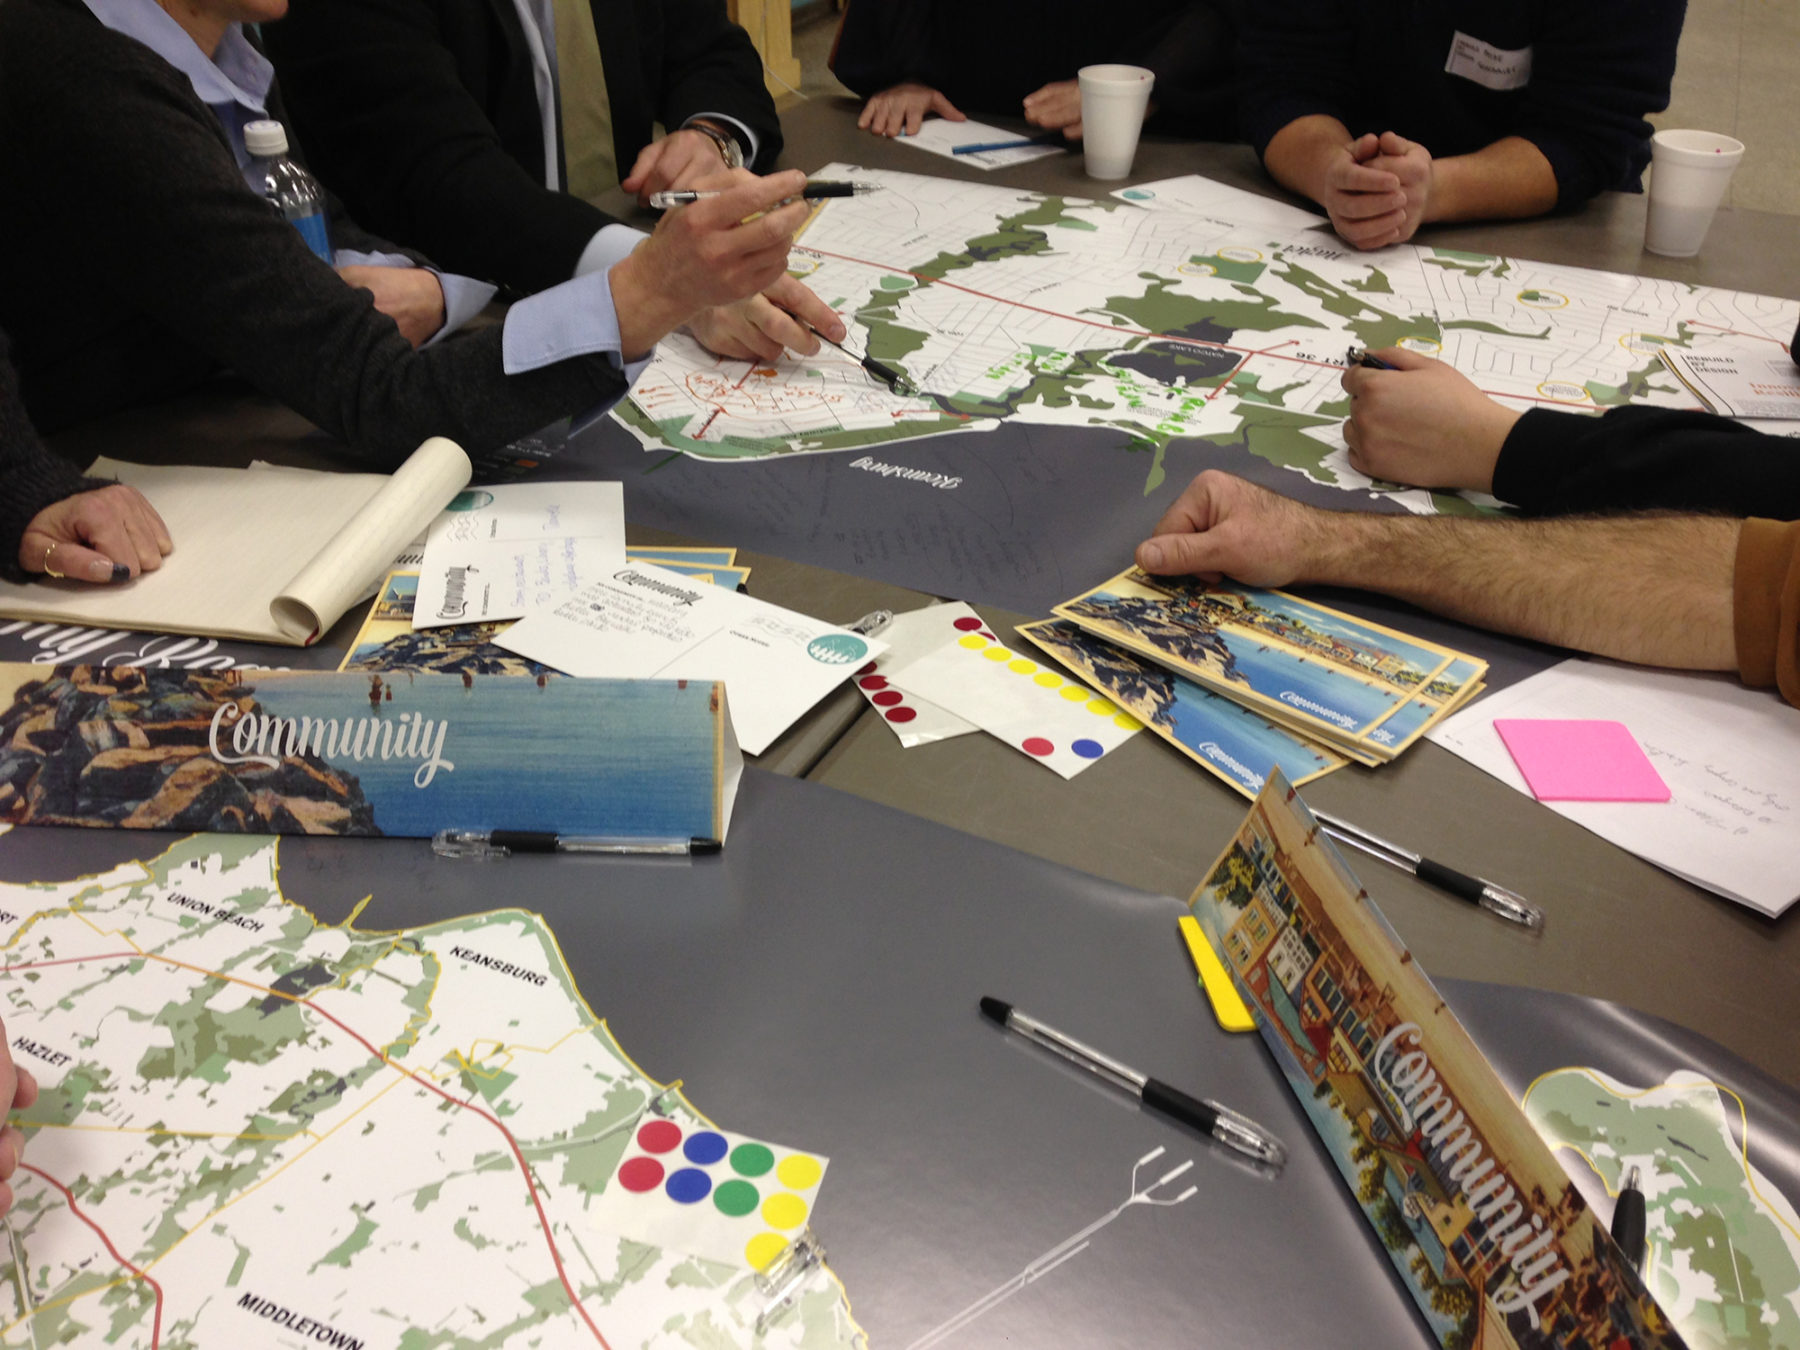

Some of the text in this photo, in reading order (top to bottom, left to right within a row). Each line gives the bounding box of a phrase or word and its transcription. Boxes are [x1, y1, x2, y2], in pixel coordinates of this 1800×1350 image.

[613, 569, 703, 607] Community
[1280, 691, 1358, 729] Community
[209, 702, 455, 789] Community
[0, 908, 19, 925] RT
[167, 892, 265, 933] UNION BEACH
[449, 945, 548, 987] KEANSBURG
[12, 1035, 72, 1068] HAZLET
[1374, 1022, 1569, 1330] Community
[237, 1291, 365, 1350] MIDDLETOWN
